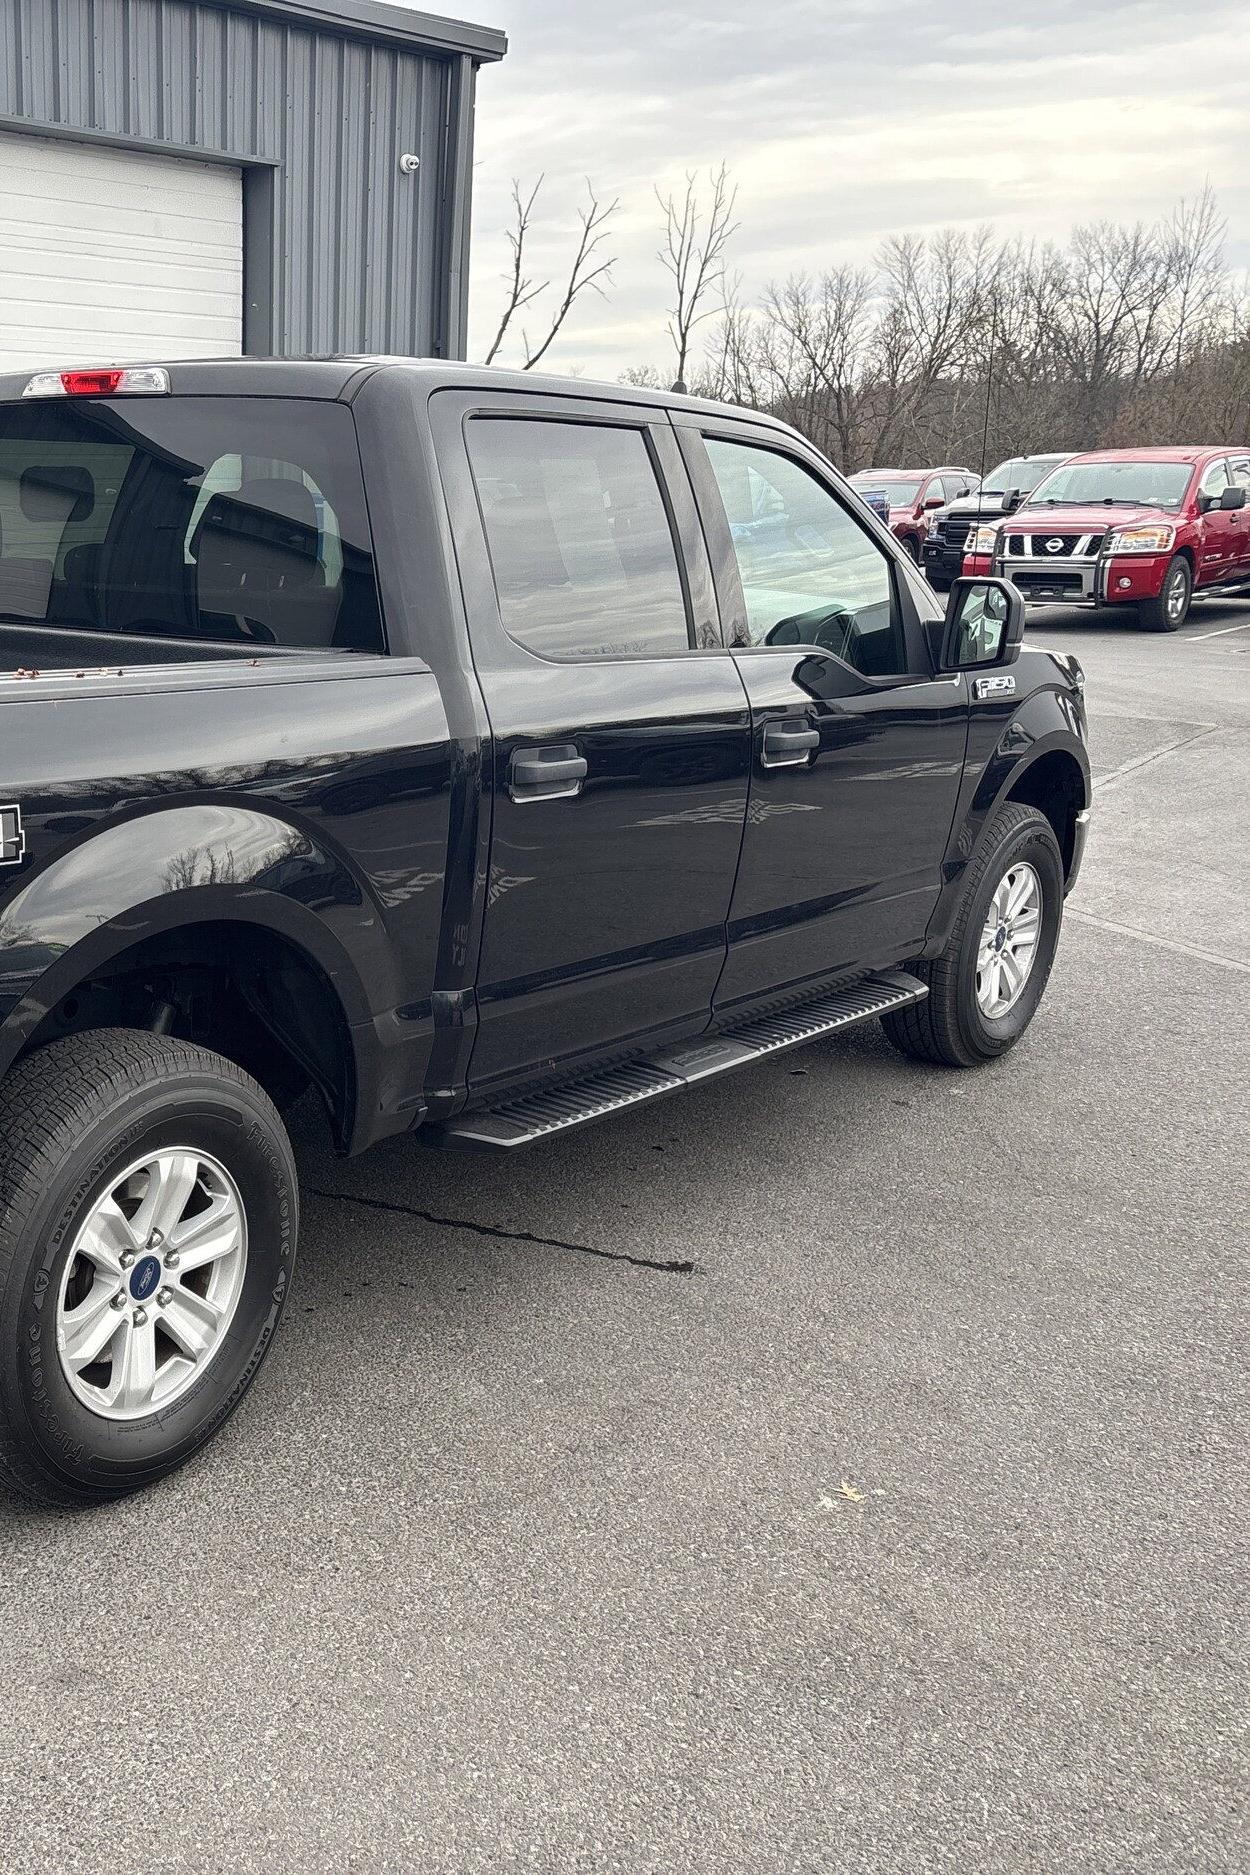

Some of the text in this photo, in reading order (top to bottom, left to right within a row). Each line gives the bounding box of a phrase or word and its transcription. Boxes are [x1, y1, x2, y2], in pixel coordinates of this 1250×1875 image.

[51, 1132, 128, 1245] DESTINATION
[246, 1120, 292, 1257] Firestone
[28, 1322, 85, 1466] Firestone
